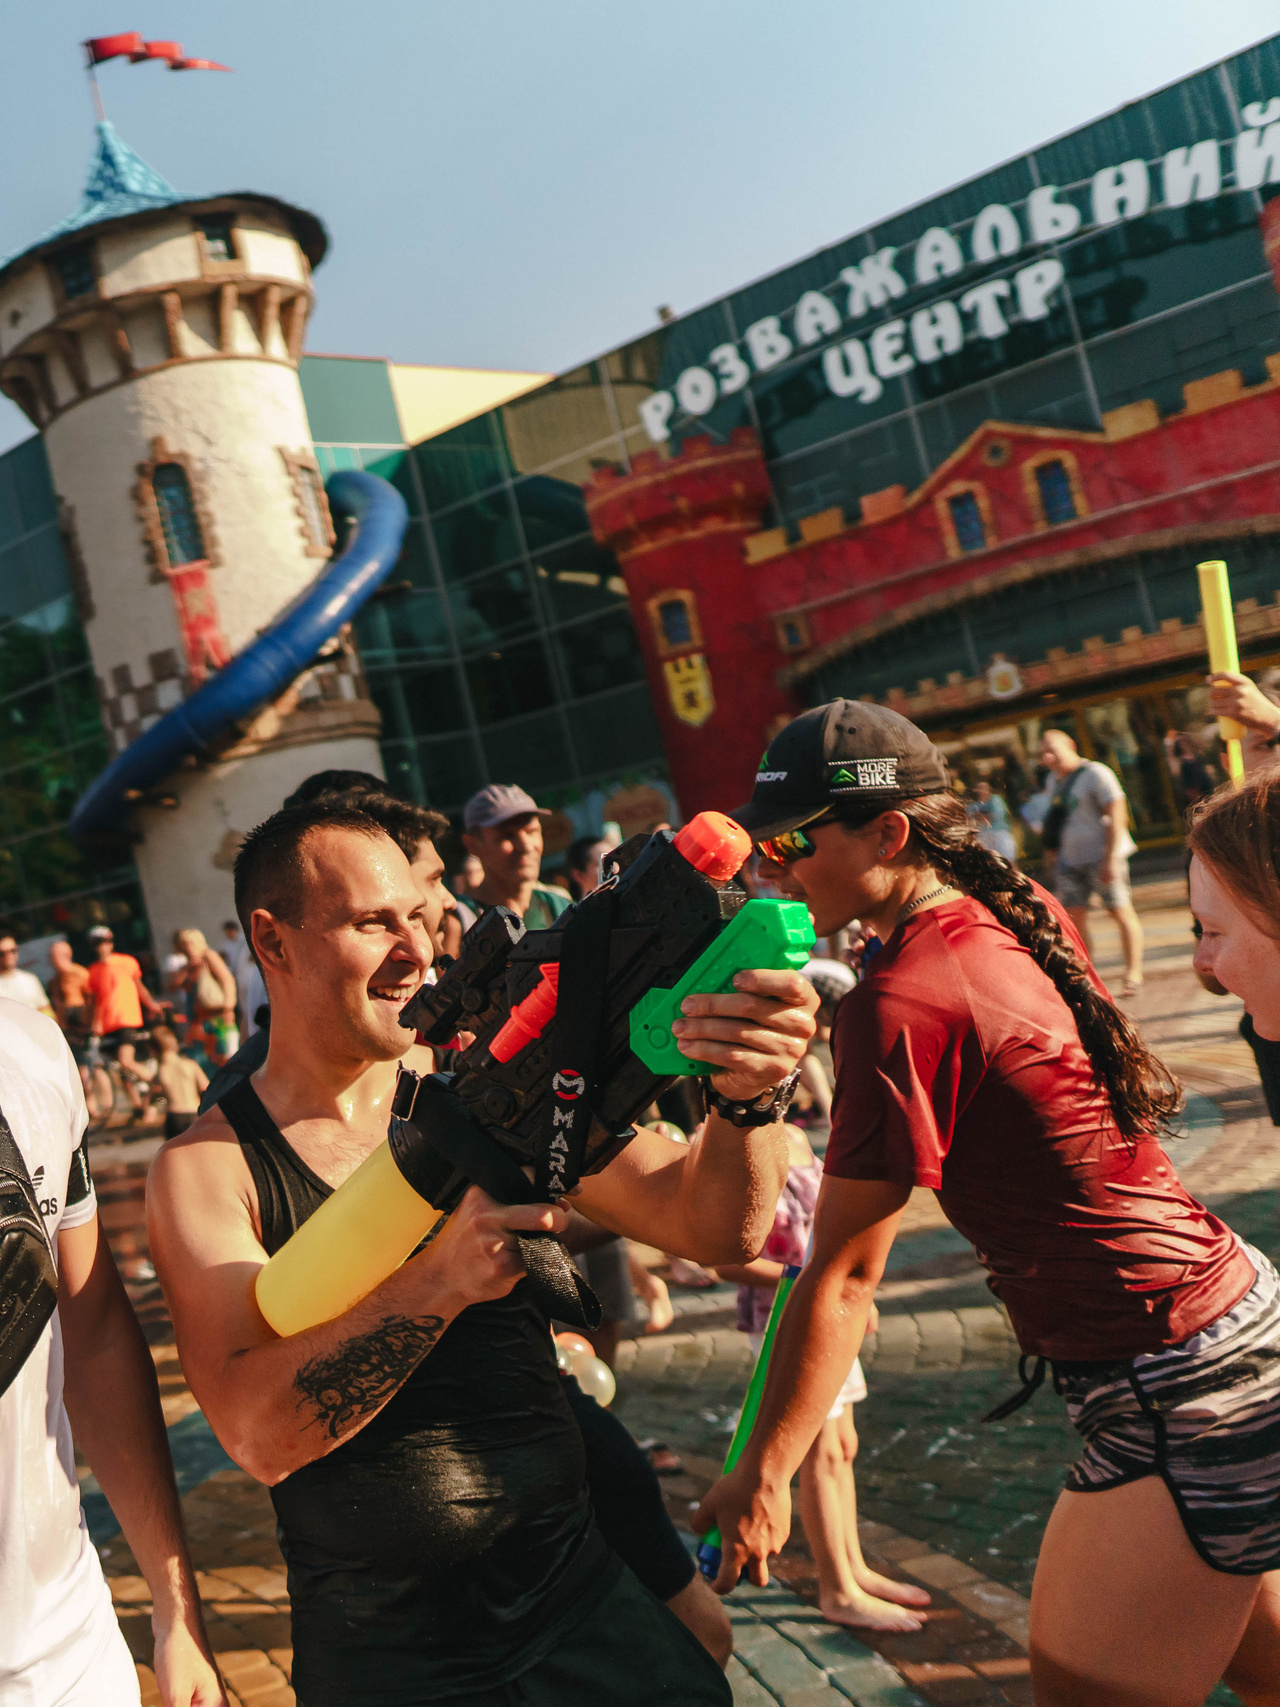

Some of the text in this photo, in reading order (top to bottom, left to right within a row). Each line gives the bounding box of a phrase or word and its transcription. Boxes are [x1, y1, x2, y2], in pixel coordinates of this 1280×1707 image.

[822, 257, 1065, 404] ЦЕНТР
[857, 761, 897, 774] MORE
[858, 771, 897, 787] BIKE
